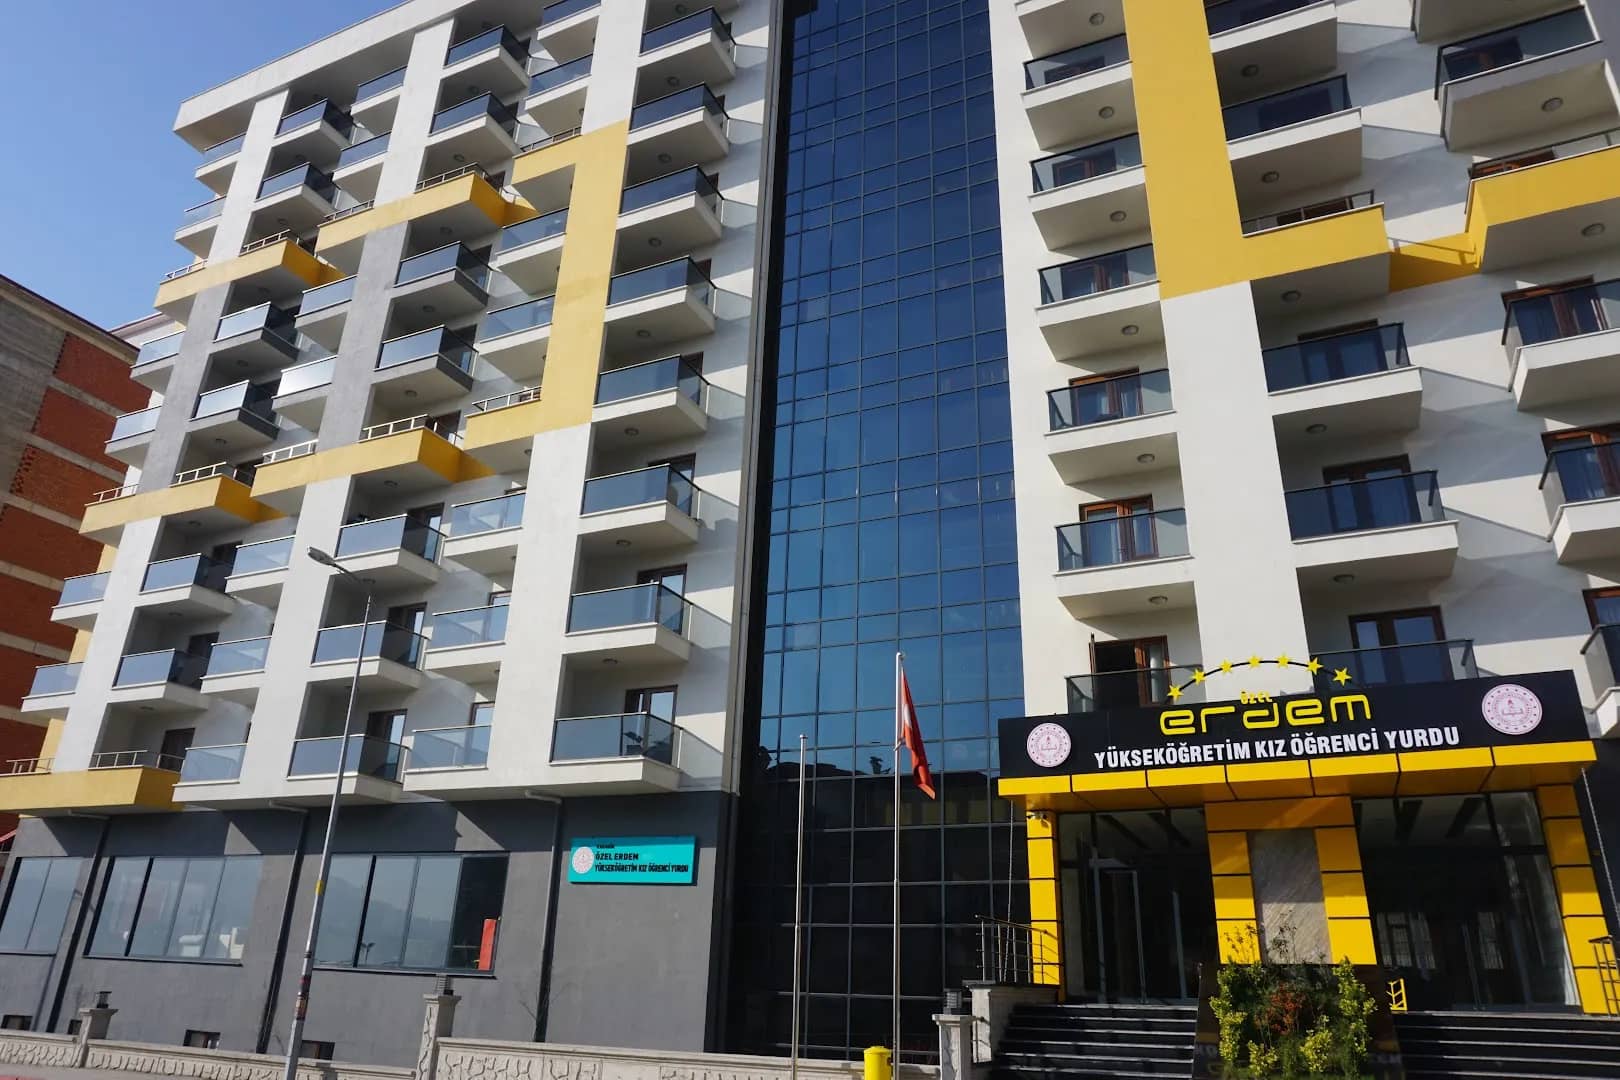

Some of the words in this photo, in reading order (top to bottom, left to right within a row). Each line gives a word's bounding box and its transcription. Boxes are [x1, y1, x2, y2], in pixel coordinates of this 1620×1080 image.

[1159, 694, 1372, 736] erdem
[1094, 738, 1250, 769] YÜKSEKÖĞRETİM
[1256, 739, 1287, 759] KIZ
[1291, 728, 1379, 756] ÖĞRENCİ
[1384, 726, 1461, 749] YURDU
[596, 852, 612, 860] ÖZEL
